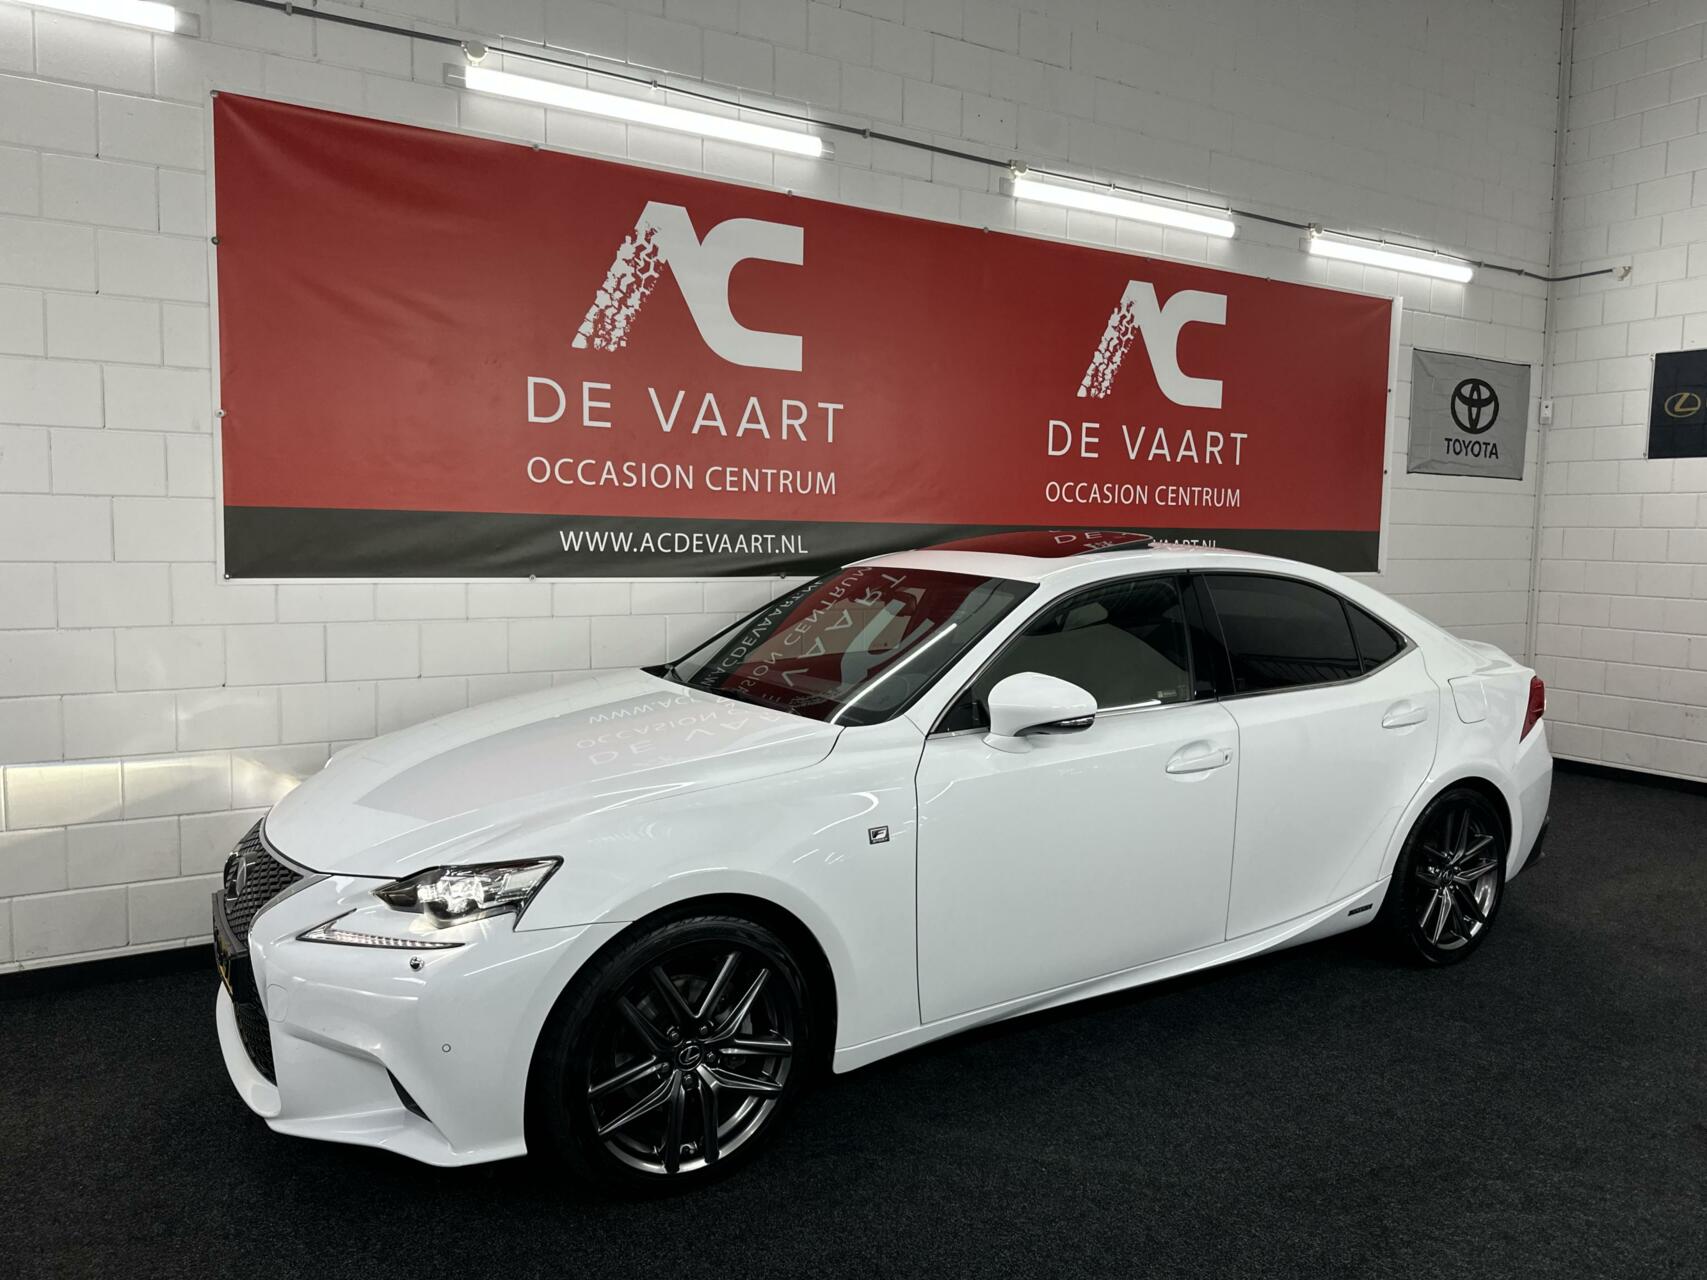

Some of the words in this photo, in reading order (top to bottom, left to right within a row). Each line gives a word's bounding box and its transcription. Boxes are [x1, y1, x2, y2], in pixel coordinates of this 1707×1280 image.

[572, 201, 803, 372] AC
[1077, 280, 1228, 409] AC
[527, 376, 612, 428] DE
[647, 387, 844, 443] VAART
[1048, 419, 1100, 458] DE
[1121, 425, 1248, 466] VAART
[1444, 437, 1499, 460] TOYOTA
[526, 456, 693, 490] OCCASION
[705, 466, 837, 495] CENTRUM
[1045, 481, 1148, 505] OCCASION
[1155, 485, 1241, 507] CENTRUM
[559, 530, 809, 554] WWW.ACDEVAART.NL
